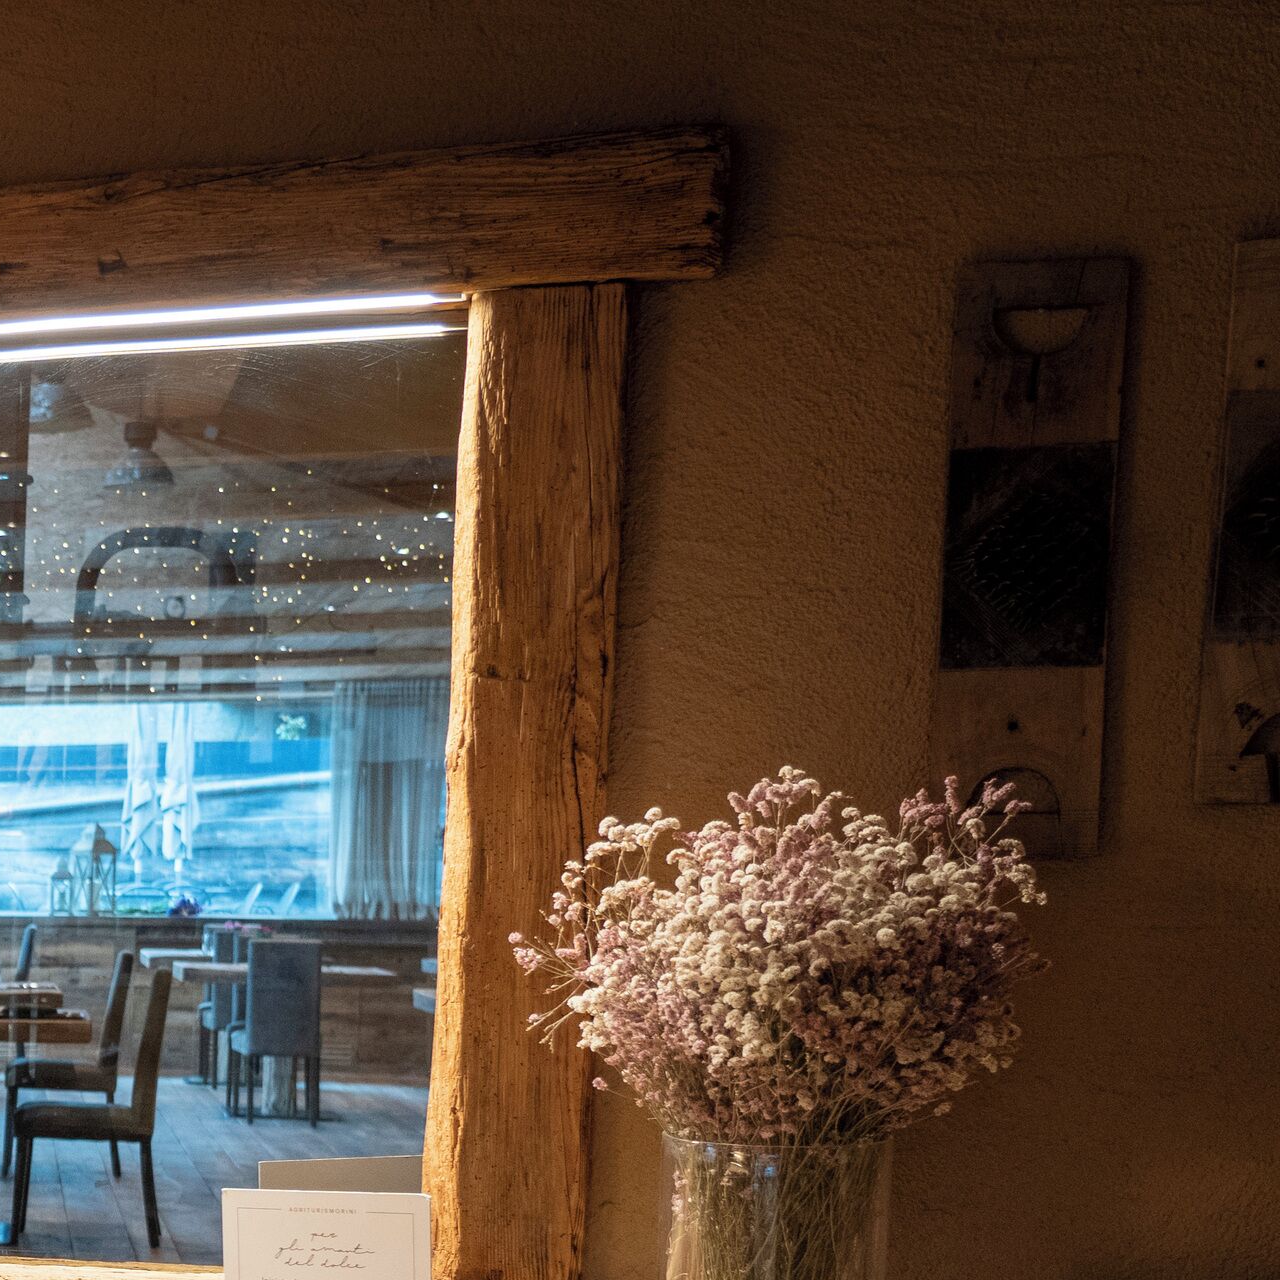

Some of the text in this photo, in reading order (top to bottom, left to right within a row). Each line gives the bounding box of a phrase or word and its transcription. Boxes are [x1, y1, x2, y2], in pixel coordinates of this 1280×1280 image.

[275, 1238, 375, 1259] gli amanti
[284, 1254, 366, 1269] del dolce
